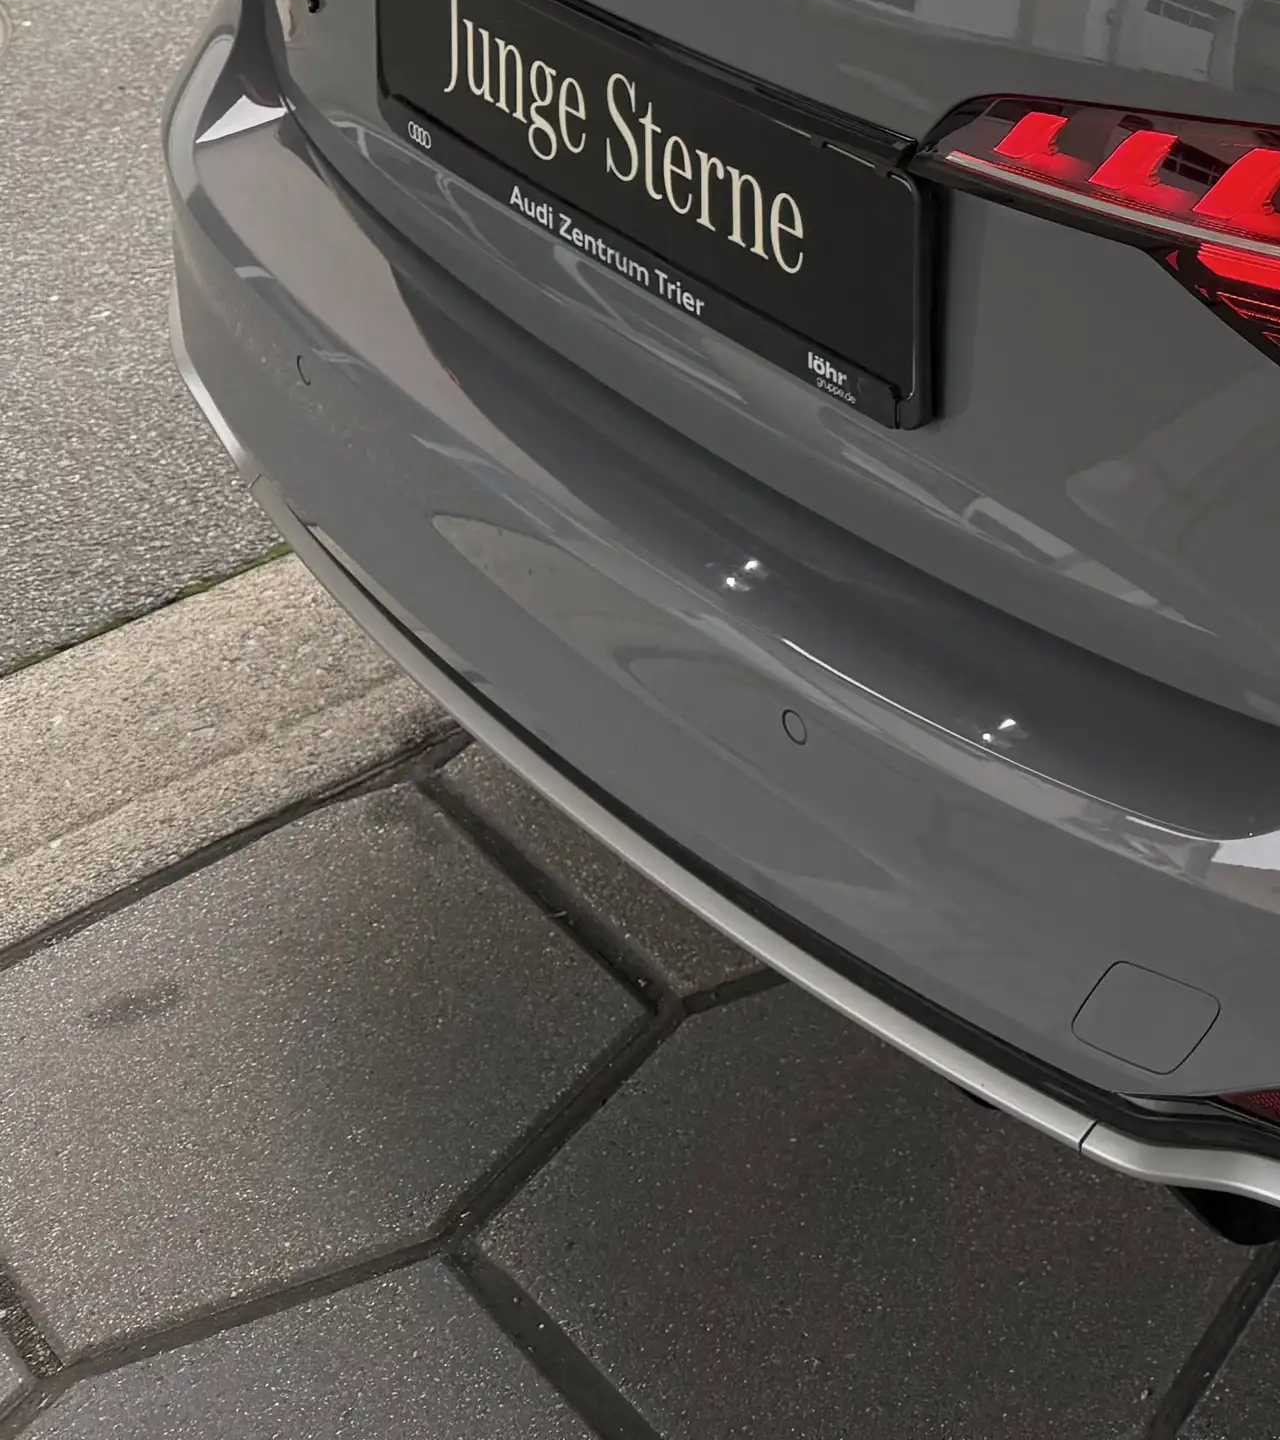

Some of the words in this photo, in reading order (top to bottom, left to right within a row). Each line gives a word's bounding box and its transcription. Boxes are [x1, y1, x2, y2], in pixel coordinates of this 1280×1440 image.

[605, 72, 805, 275] Sterne
[509, 185, 553, 230] Audi
[558, 212, 650, 287] Zentrum
[653, 268, 705, 317] Trier
[807, 351, 848, 386] löhr
